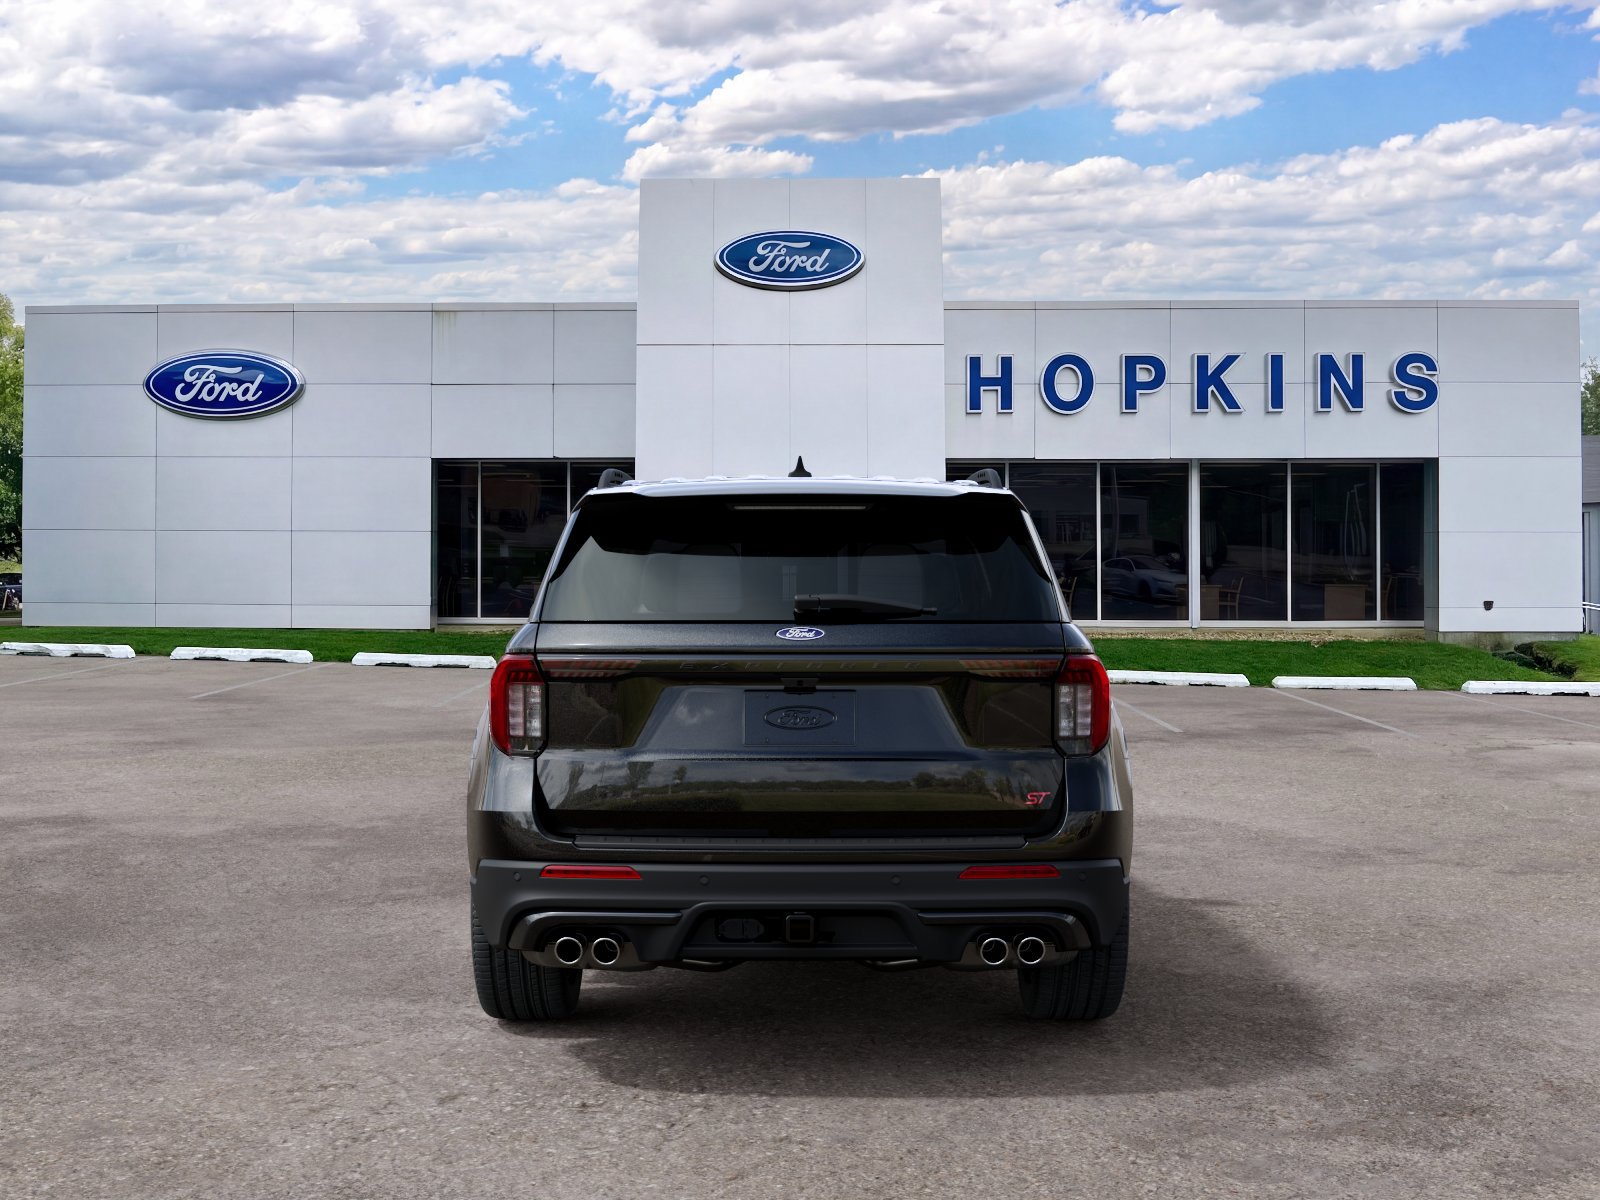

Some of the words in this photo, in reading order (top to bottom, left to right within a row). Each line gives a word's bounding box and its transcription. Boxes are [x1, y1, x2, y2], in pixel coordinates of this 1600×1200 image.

[749, 240, 831, 272] Ford
[175, 364, 265, 402] Ford
[966, 352, 1438, 415] HOPKINS
[786, 628, 816, 638] Ford
[1025, 791, 1051, 805] ST
